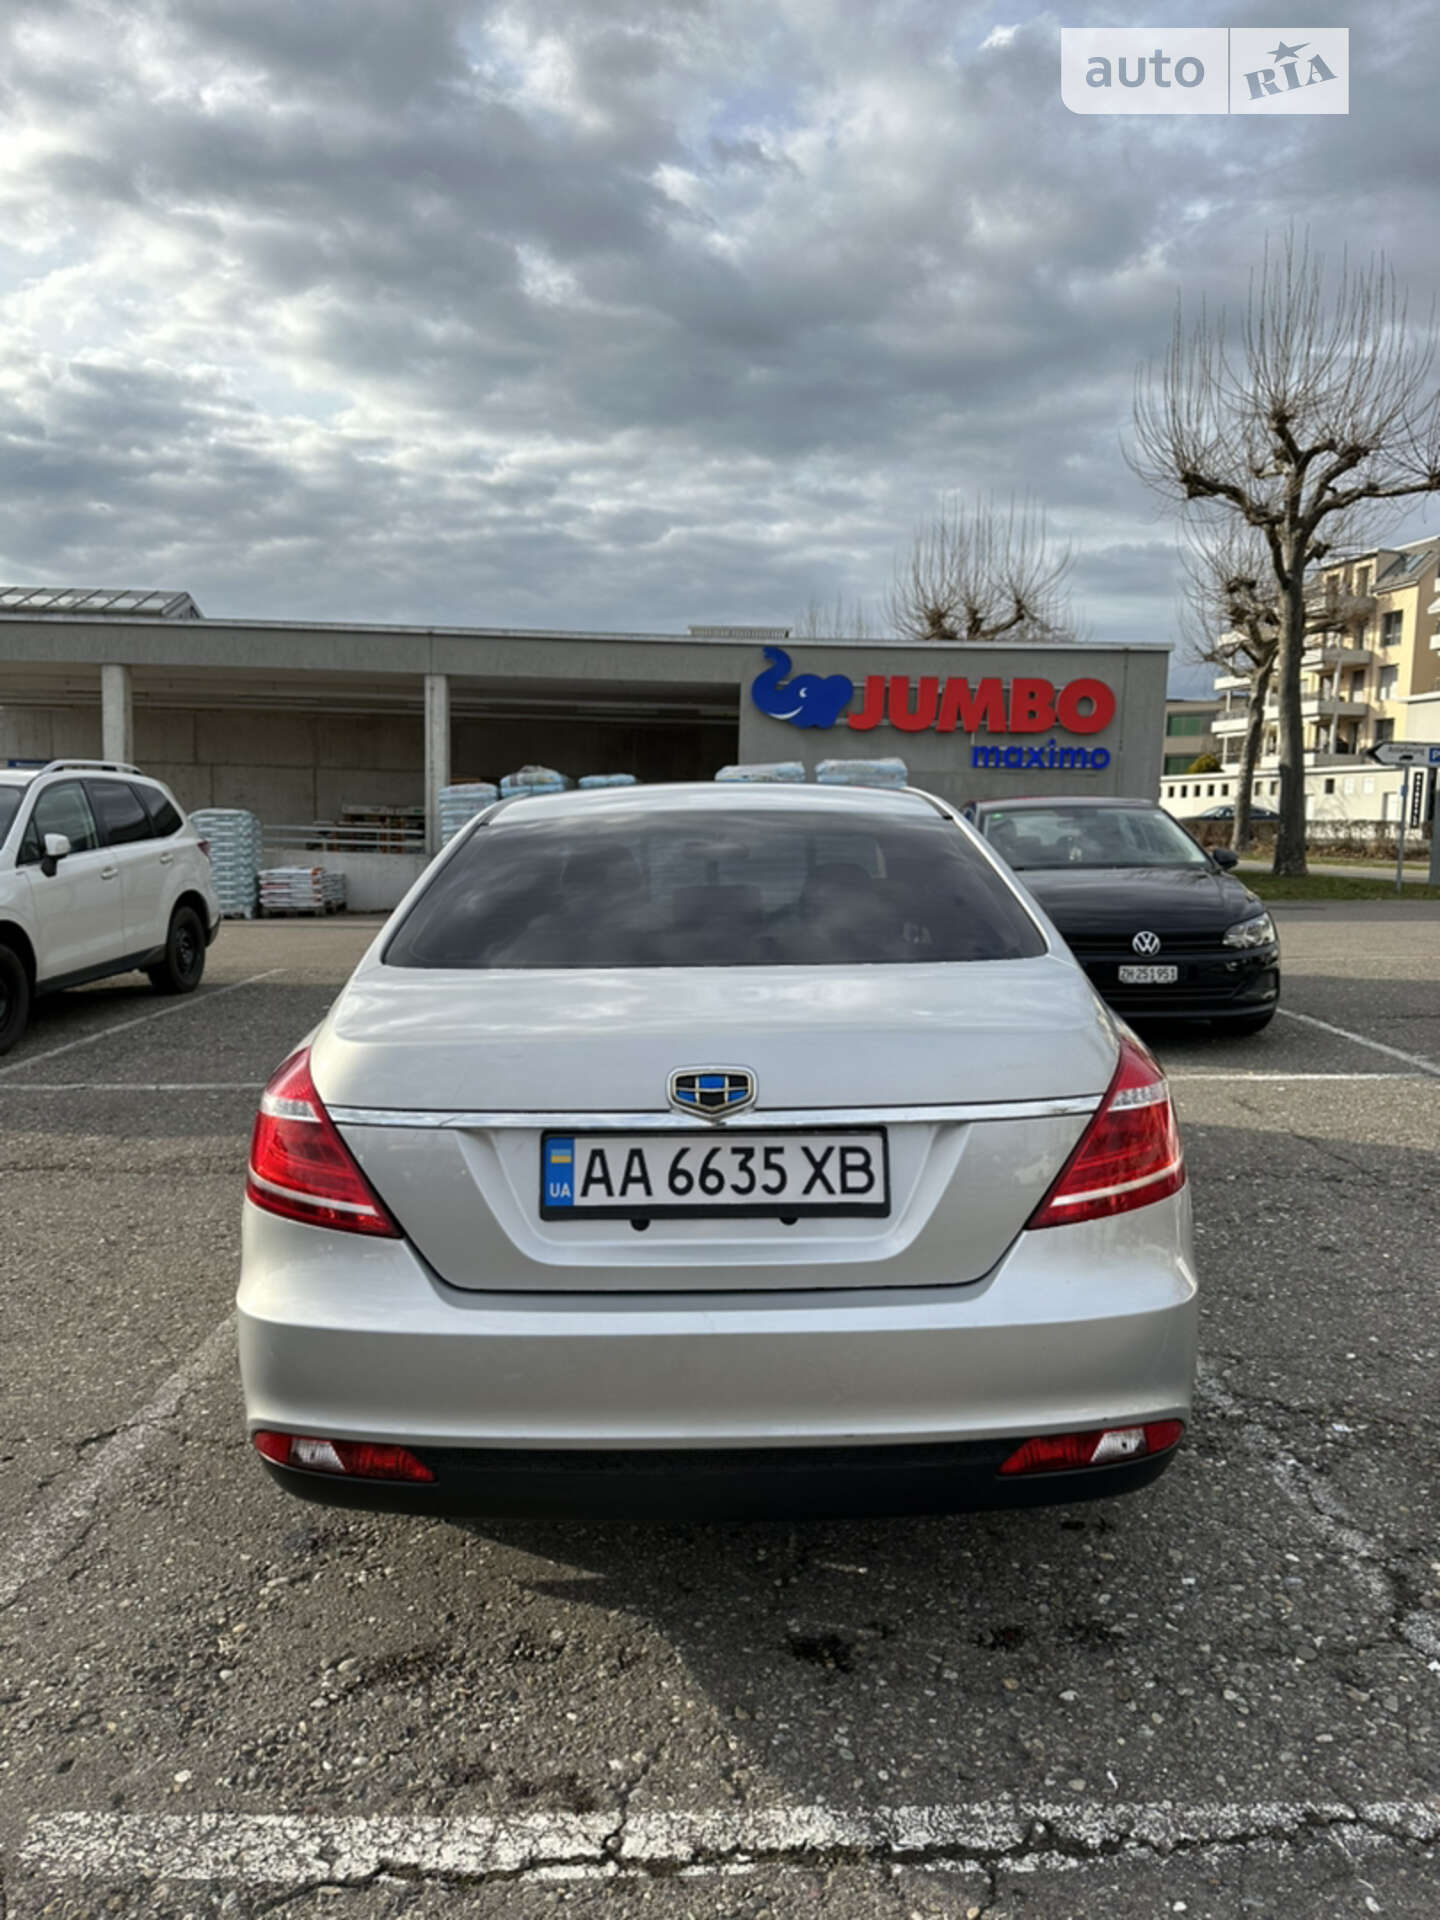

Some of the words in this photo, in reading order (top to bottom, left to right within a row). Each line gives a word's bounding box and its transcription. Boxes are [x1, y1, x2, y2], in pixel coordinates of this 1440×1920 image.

[846, 674, 1117, 735] JUMBO
[970, 737, 1111, 770] maximo
[549, 1182, 572, 1198] UA
[580, 1147, 654, 1198] AA
[667, 1146, 788, 1196] 6635
[800, 1145, 876, 1196] XB
